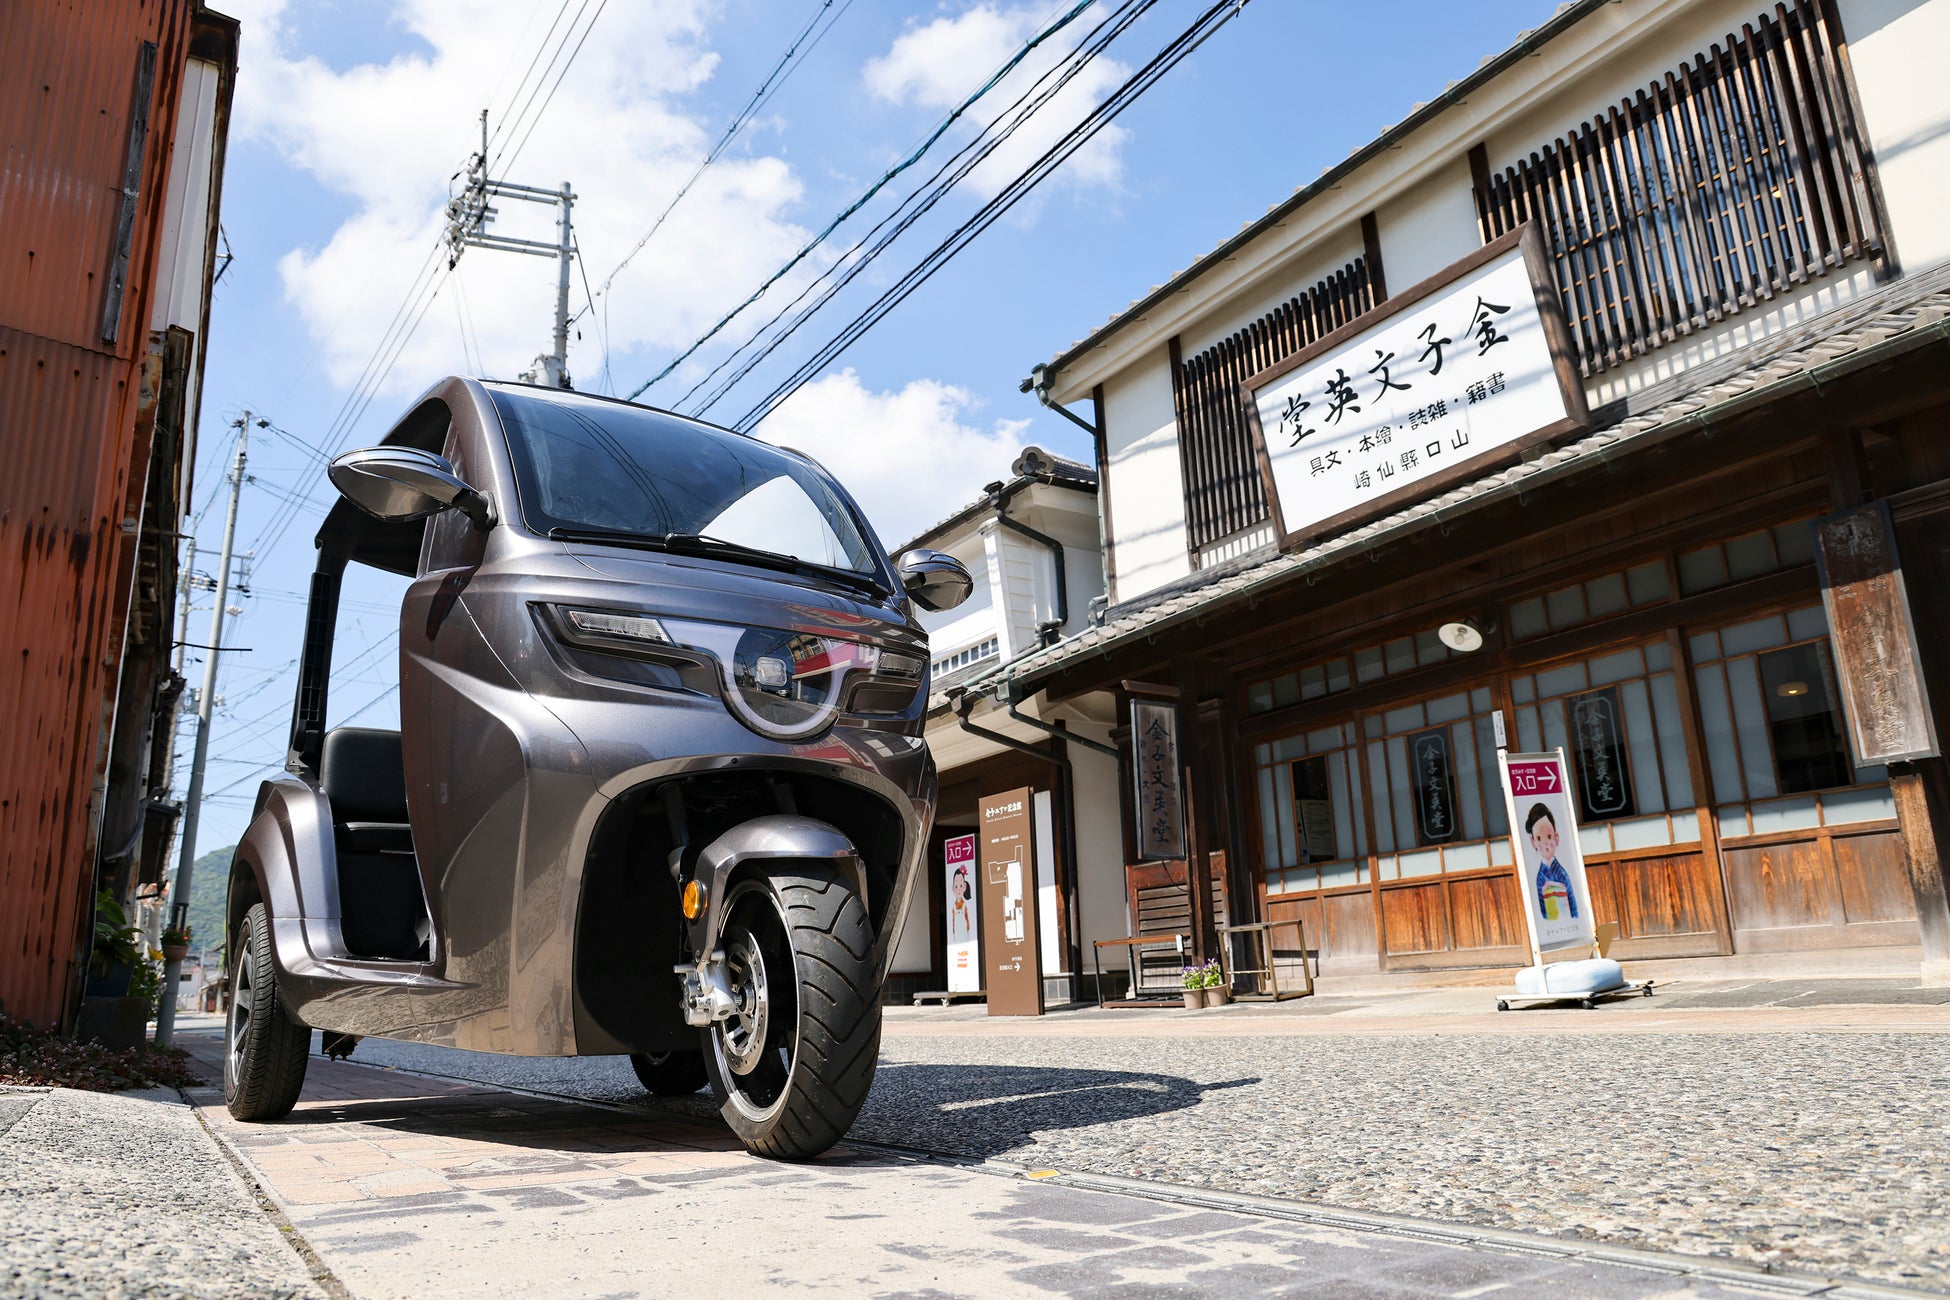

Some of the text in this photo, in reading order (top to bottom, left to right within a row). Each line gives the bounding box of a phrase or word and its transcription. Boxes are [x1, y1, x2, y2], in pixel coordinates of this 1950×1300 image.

[1279, 296, 1511, 448] 金子文英堂
[1354, 428, 1470, 490] 山口縣仙崎
[1145, 718, 1171, 844] 金子文英堂
[1423, 744, 1445, 829] 金子文英堂
[1516, 775, 1537, 791] 入口
[1585, 710, 1614, 802] 金子文英堂
[948, 846, 962, 861] 入口
